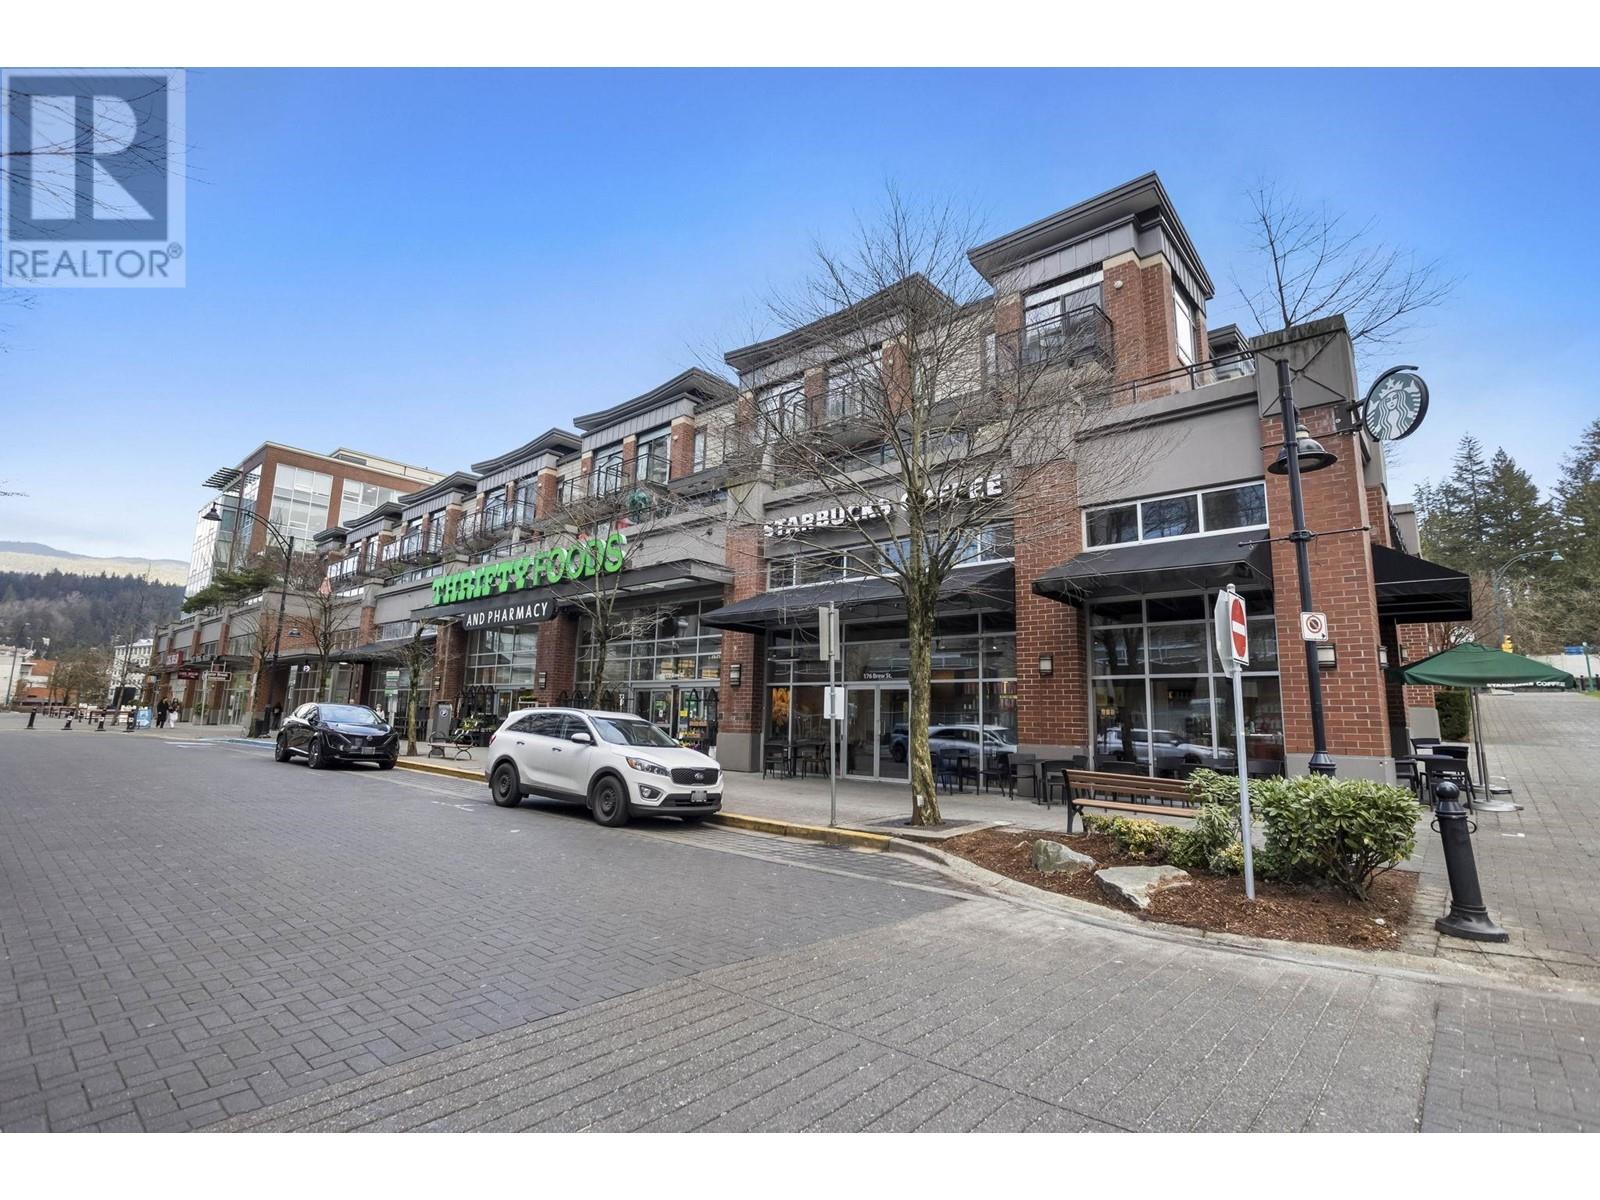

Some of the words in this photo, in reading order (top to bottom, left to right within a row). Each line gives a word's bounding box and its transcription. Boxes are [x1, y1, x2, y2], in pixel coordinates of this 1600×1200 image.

[763, 498, 892, 537] STARBUCKS
[900, 473, 1003, 512] FFEE
[431, 556, 535, 606] THRIFTY
[532, 533, 628, 586] FOODS
[466, 613, 486, 627] AND
[487, 601, 549, 624] PHARMACY
